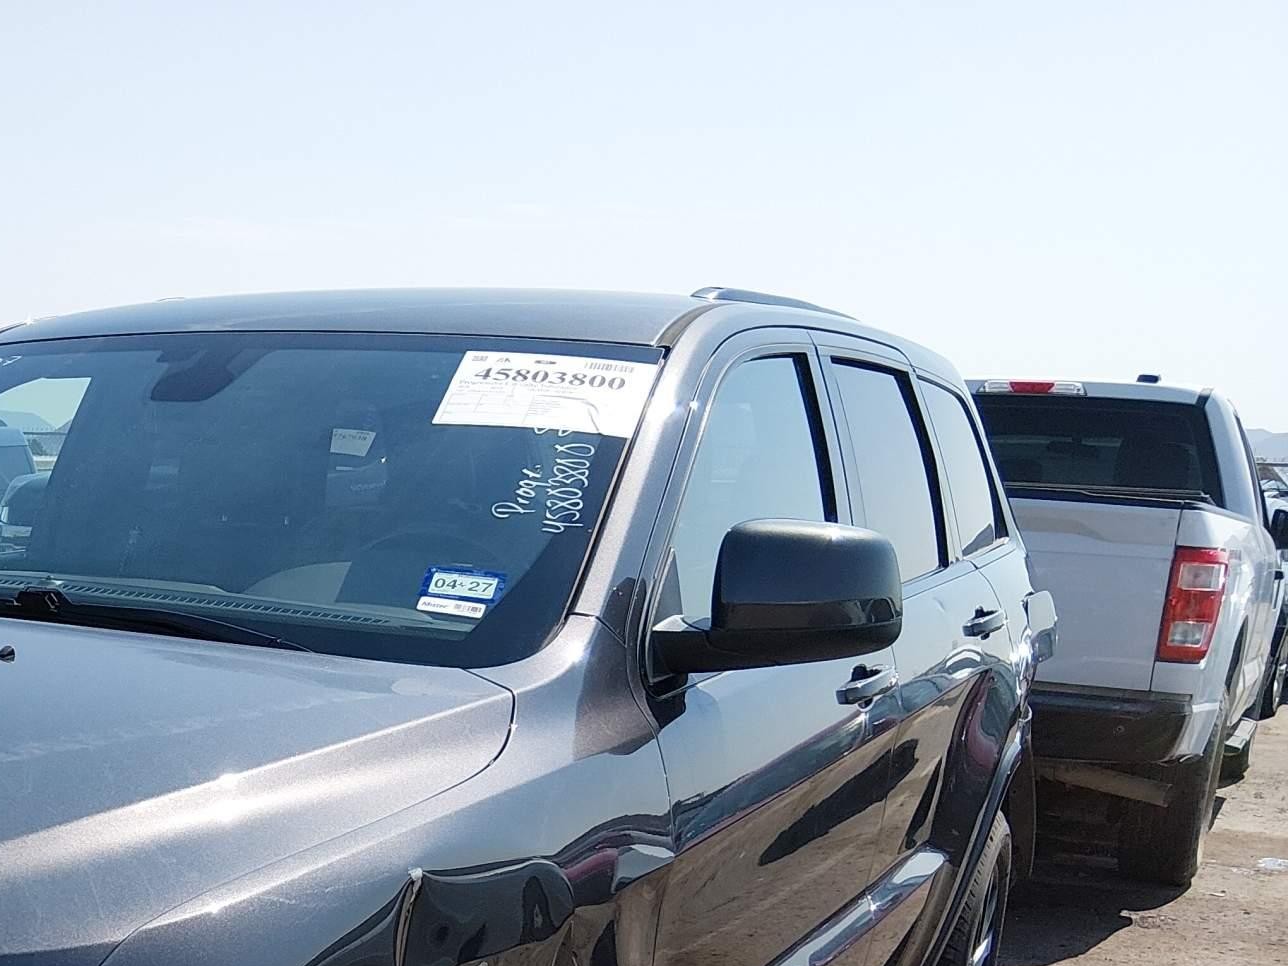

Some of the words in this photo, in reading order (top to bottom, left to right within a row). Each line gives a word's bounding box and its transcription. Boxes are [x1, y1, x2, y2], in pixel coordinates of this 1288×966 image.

[473, 366, 626, 390] 45803800
[541, 443, 595, 533] 45803800
[434, 578, 458, 590] 04
[467, 581, 494, 593] 27
